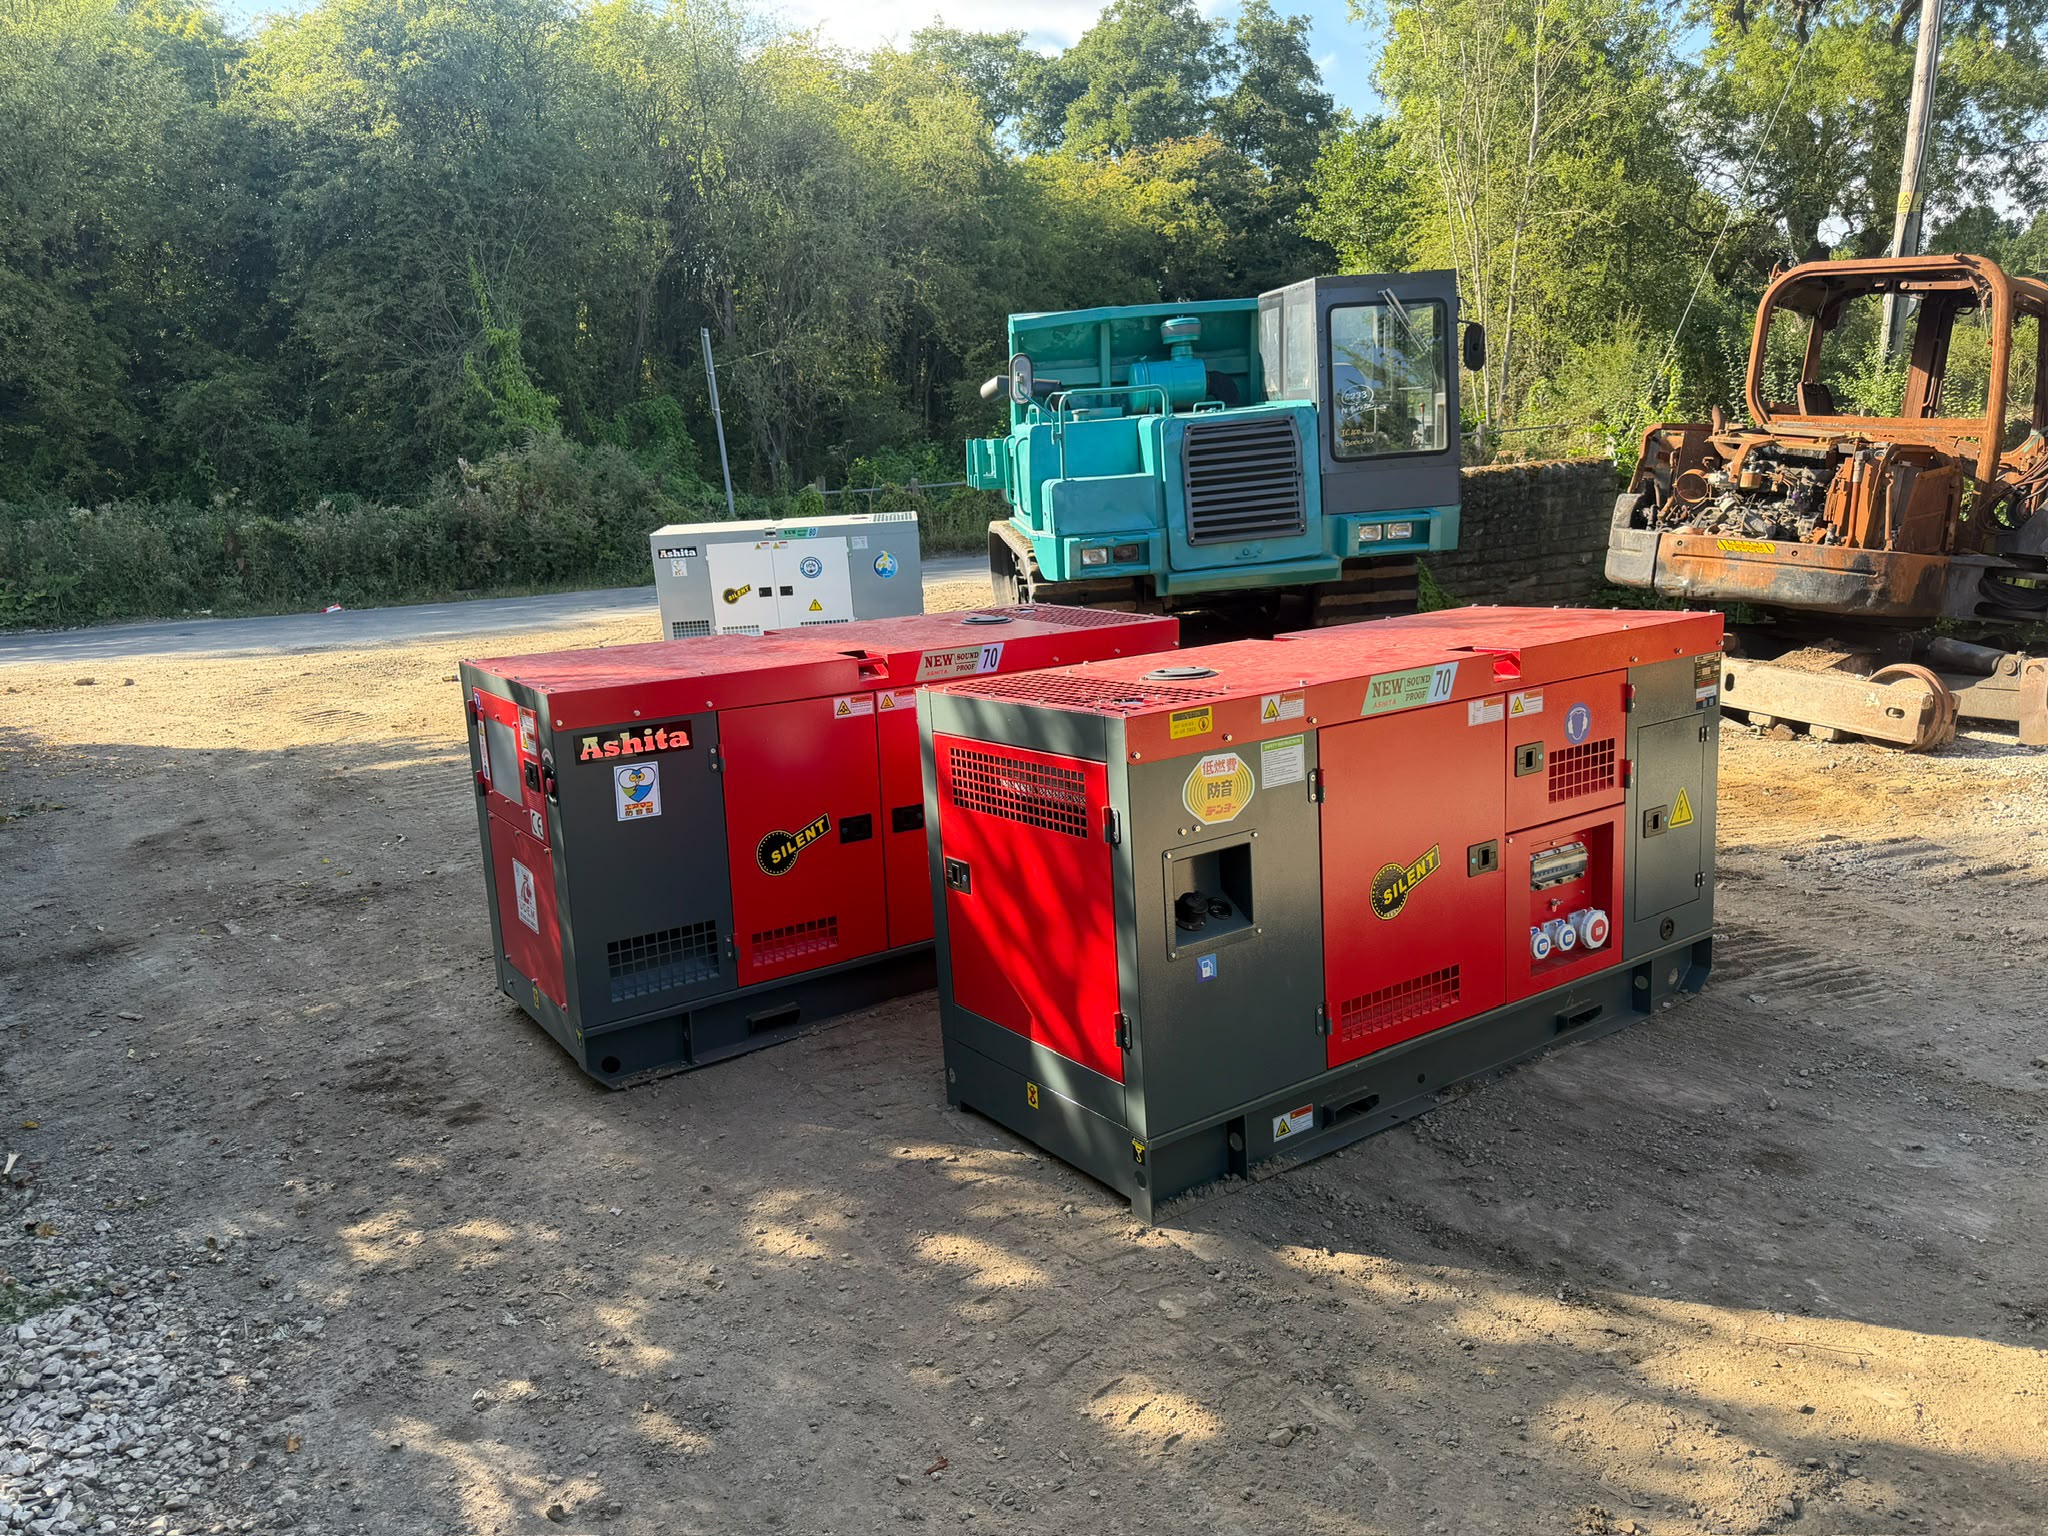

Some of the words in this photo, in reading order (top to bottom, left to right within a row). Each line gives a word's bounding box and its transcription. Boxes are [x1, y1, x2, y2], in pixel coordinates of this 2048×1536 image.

[659, 549, 697, 558] Ashita
[728, 585, 749, 601] SILENT
[924, 653, 955, 668] NEW
[956, 652, 979, 661] SOUND
[983, 647, 998, 669] 70
[956, 664, 976, 672] PROOF
[1372, 677, 1406, 698] NEW
[1406, 675, 1431, 687] SOUND
[1434, 668, 1451, 697] 70
[1405, 690, 1427, 701] PROOF
[580, 728, 690, 761] Ashita
[1203, 757, 1237, 775] 低燃費
[1207, 780, 1233, 799] 防音
[771, 819, 825, 864] SILENT
[1383, 852, 1435, 905] SILENT
